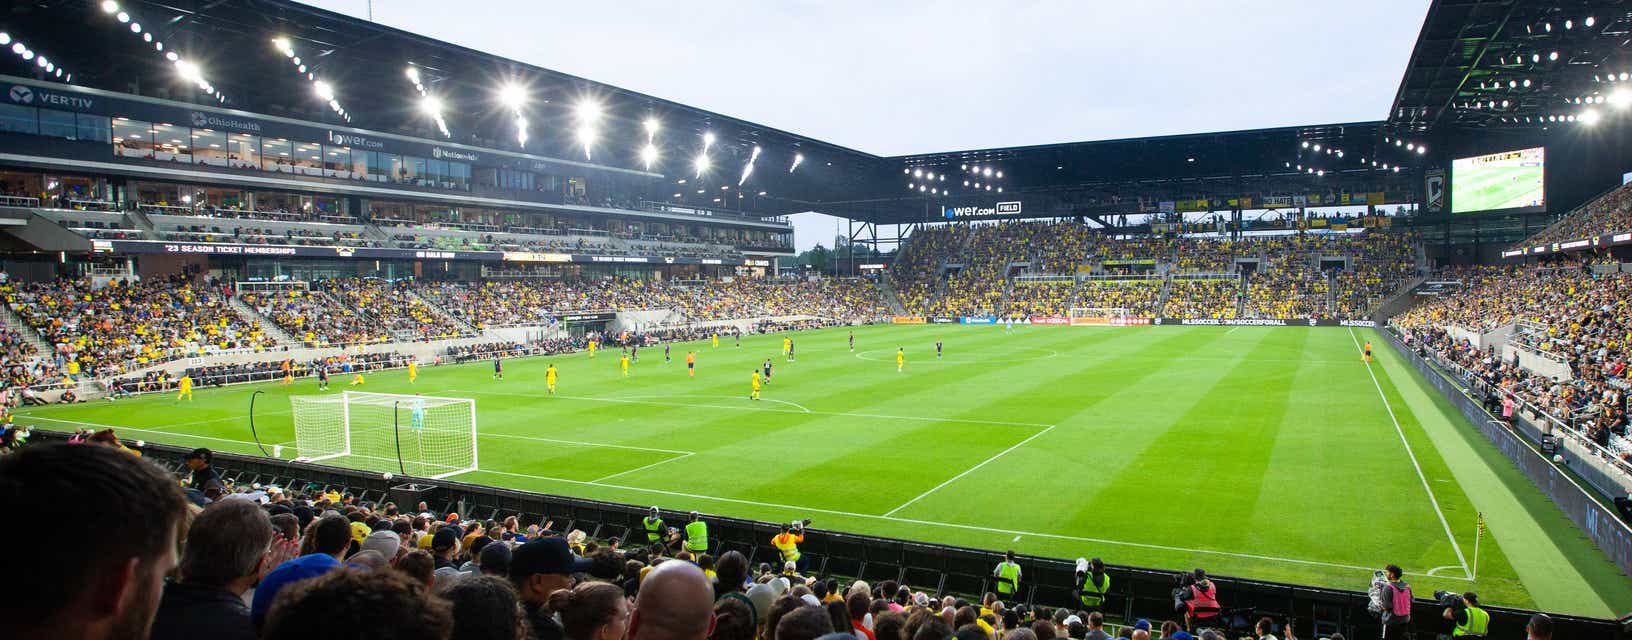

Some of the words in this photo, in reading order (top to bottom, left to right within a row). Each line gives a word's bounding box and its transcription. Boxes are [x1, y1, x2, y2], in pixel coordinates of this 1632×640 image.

[40, 94, 93, 109] VERTIV
[208, 116, 261, 131] OhioHealth
[1000, 204, 1018, 212] FIELD
[181, 245, 214, 253] SEASON
[216, 246, 243, 254] TICKET
[244, 247, 296, 255] MEMBERSHIPS
